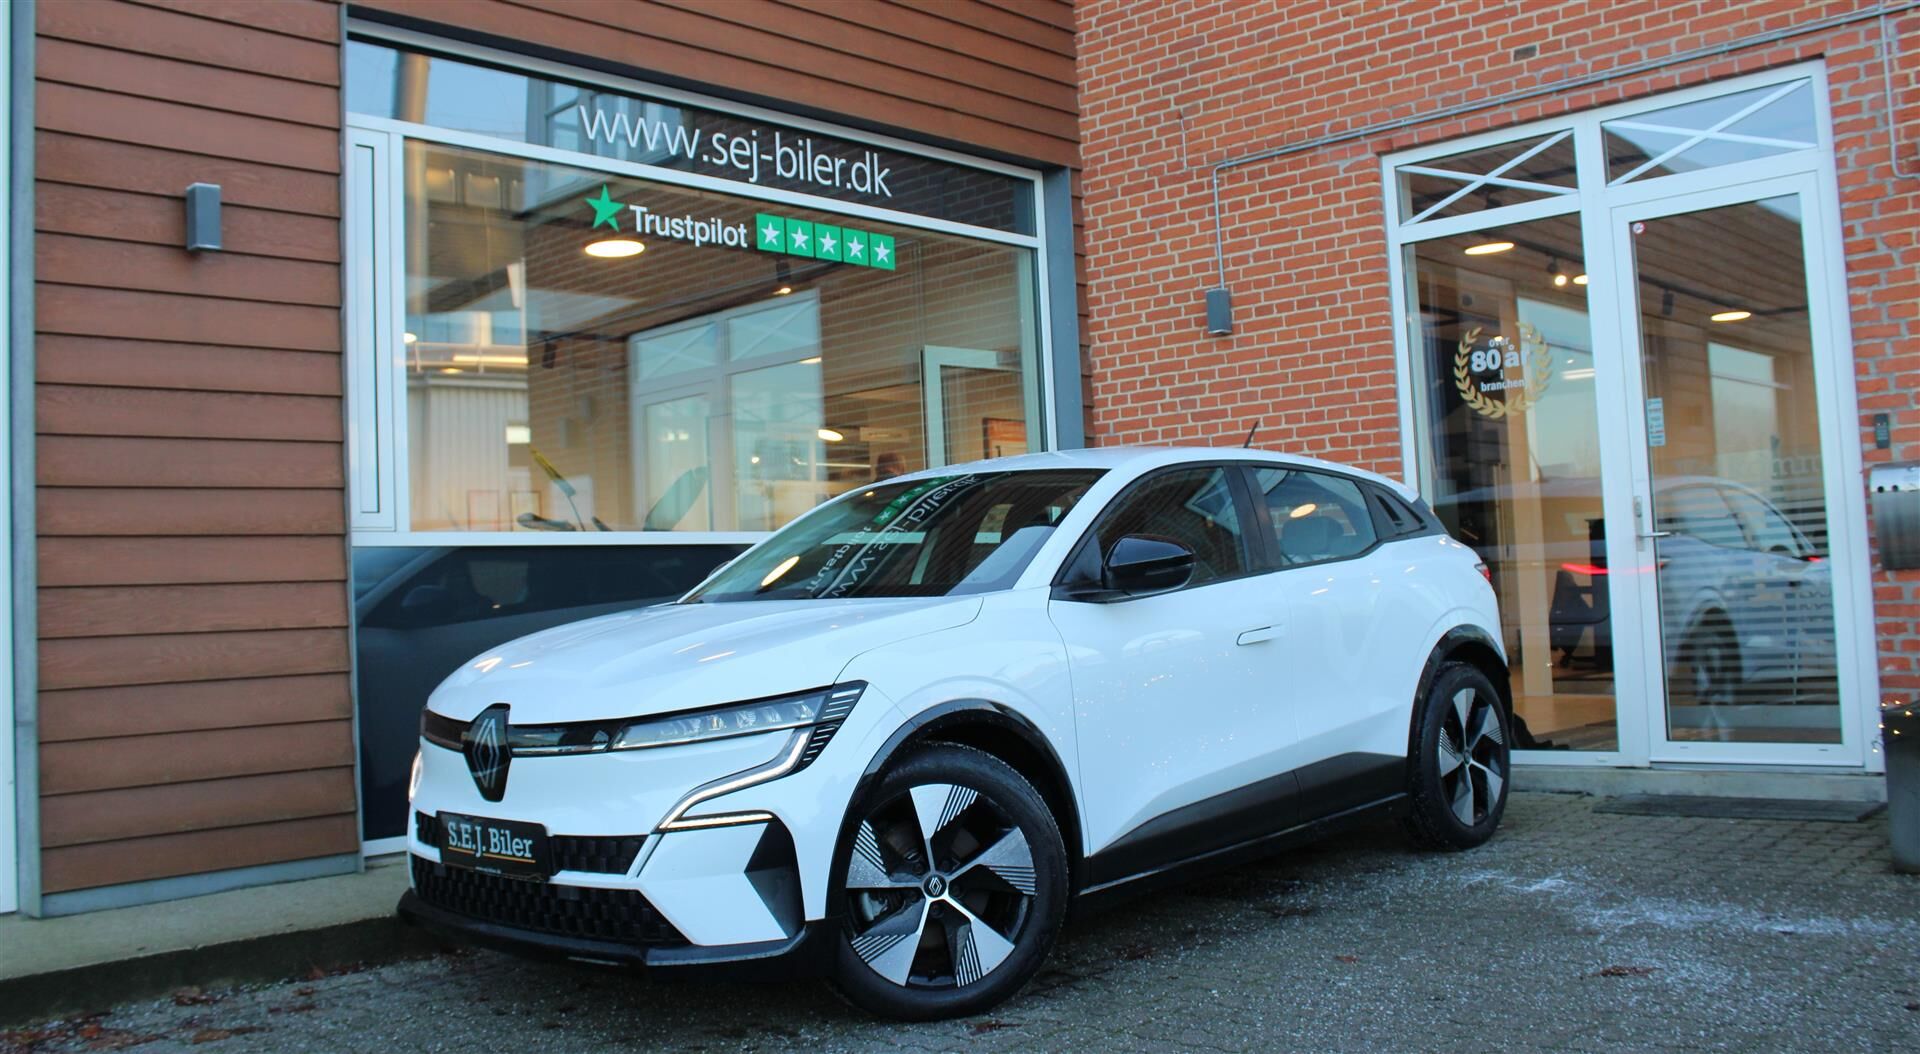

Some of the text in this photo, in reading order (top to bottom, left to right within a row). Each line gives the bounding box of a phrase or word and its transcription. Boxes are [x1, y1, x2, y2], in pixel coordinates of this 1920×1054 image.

[579, 104, 893, 198] www.sej-biler.dk
[629, 204, 748, 249] Trustpilot
[1471, 344, 1529, 373] 80 år
[1488, 337, 1511, 348] over
[1480, 378, 1527, 392] branchen
[447, 821, 533, 858] S.E.J. Biler
